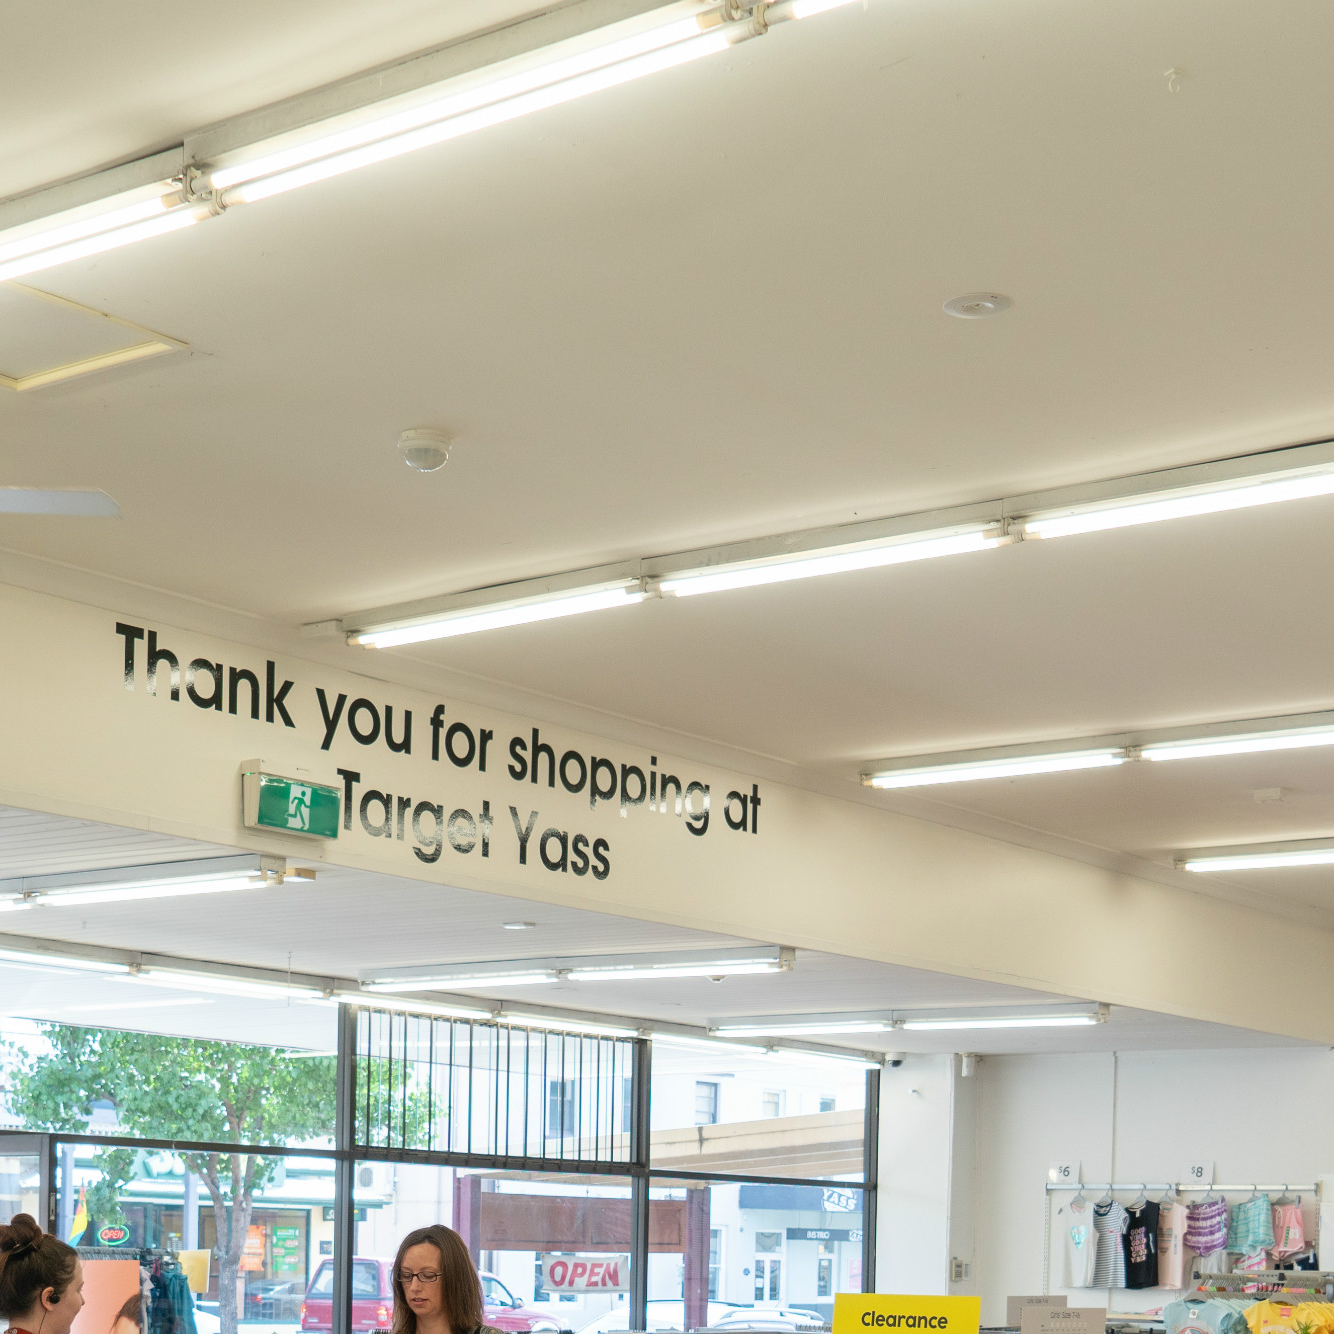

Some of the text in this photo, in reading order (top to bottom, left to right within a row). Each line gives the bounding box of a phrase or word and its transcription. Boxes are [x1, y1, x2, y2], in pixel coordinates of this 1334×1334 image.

[116, 622, 761, 837] Thank you for shopping at
[337, 769, 610, 880] Target Yass
[1058, 1166, 1070, 1177] $6
[1191, 1166, 1203, 1178] $8
[823, 1188, 857, 1211] YASS
[101, 1228, 125, 1240] OPEN
[807, 1231, 830, 1239] BISTRO
[549, 1260, 620, 1288] OPEN
[861, 1310, 948, 1329] Clearance
